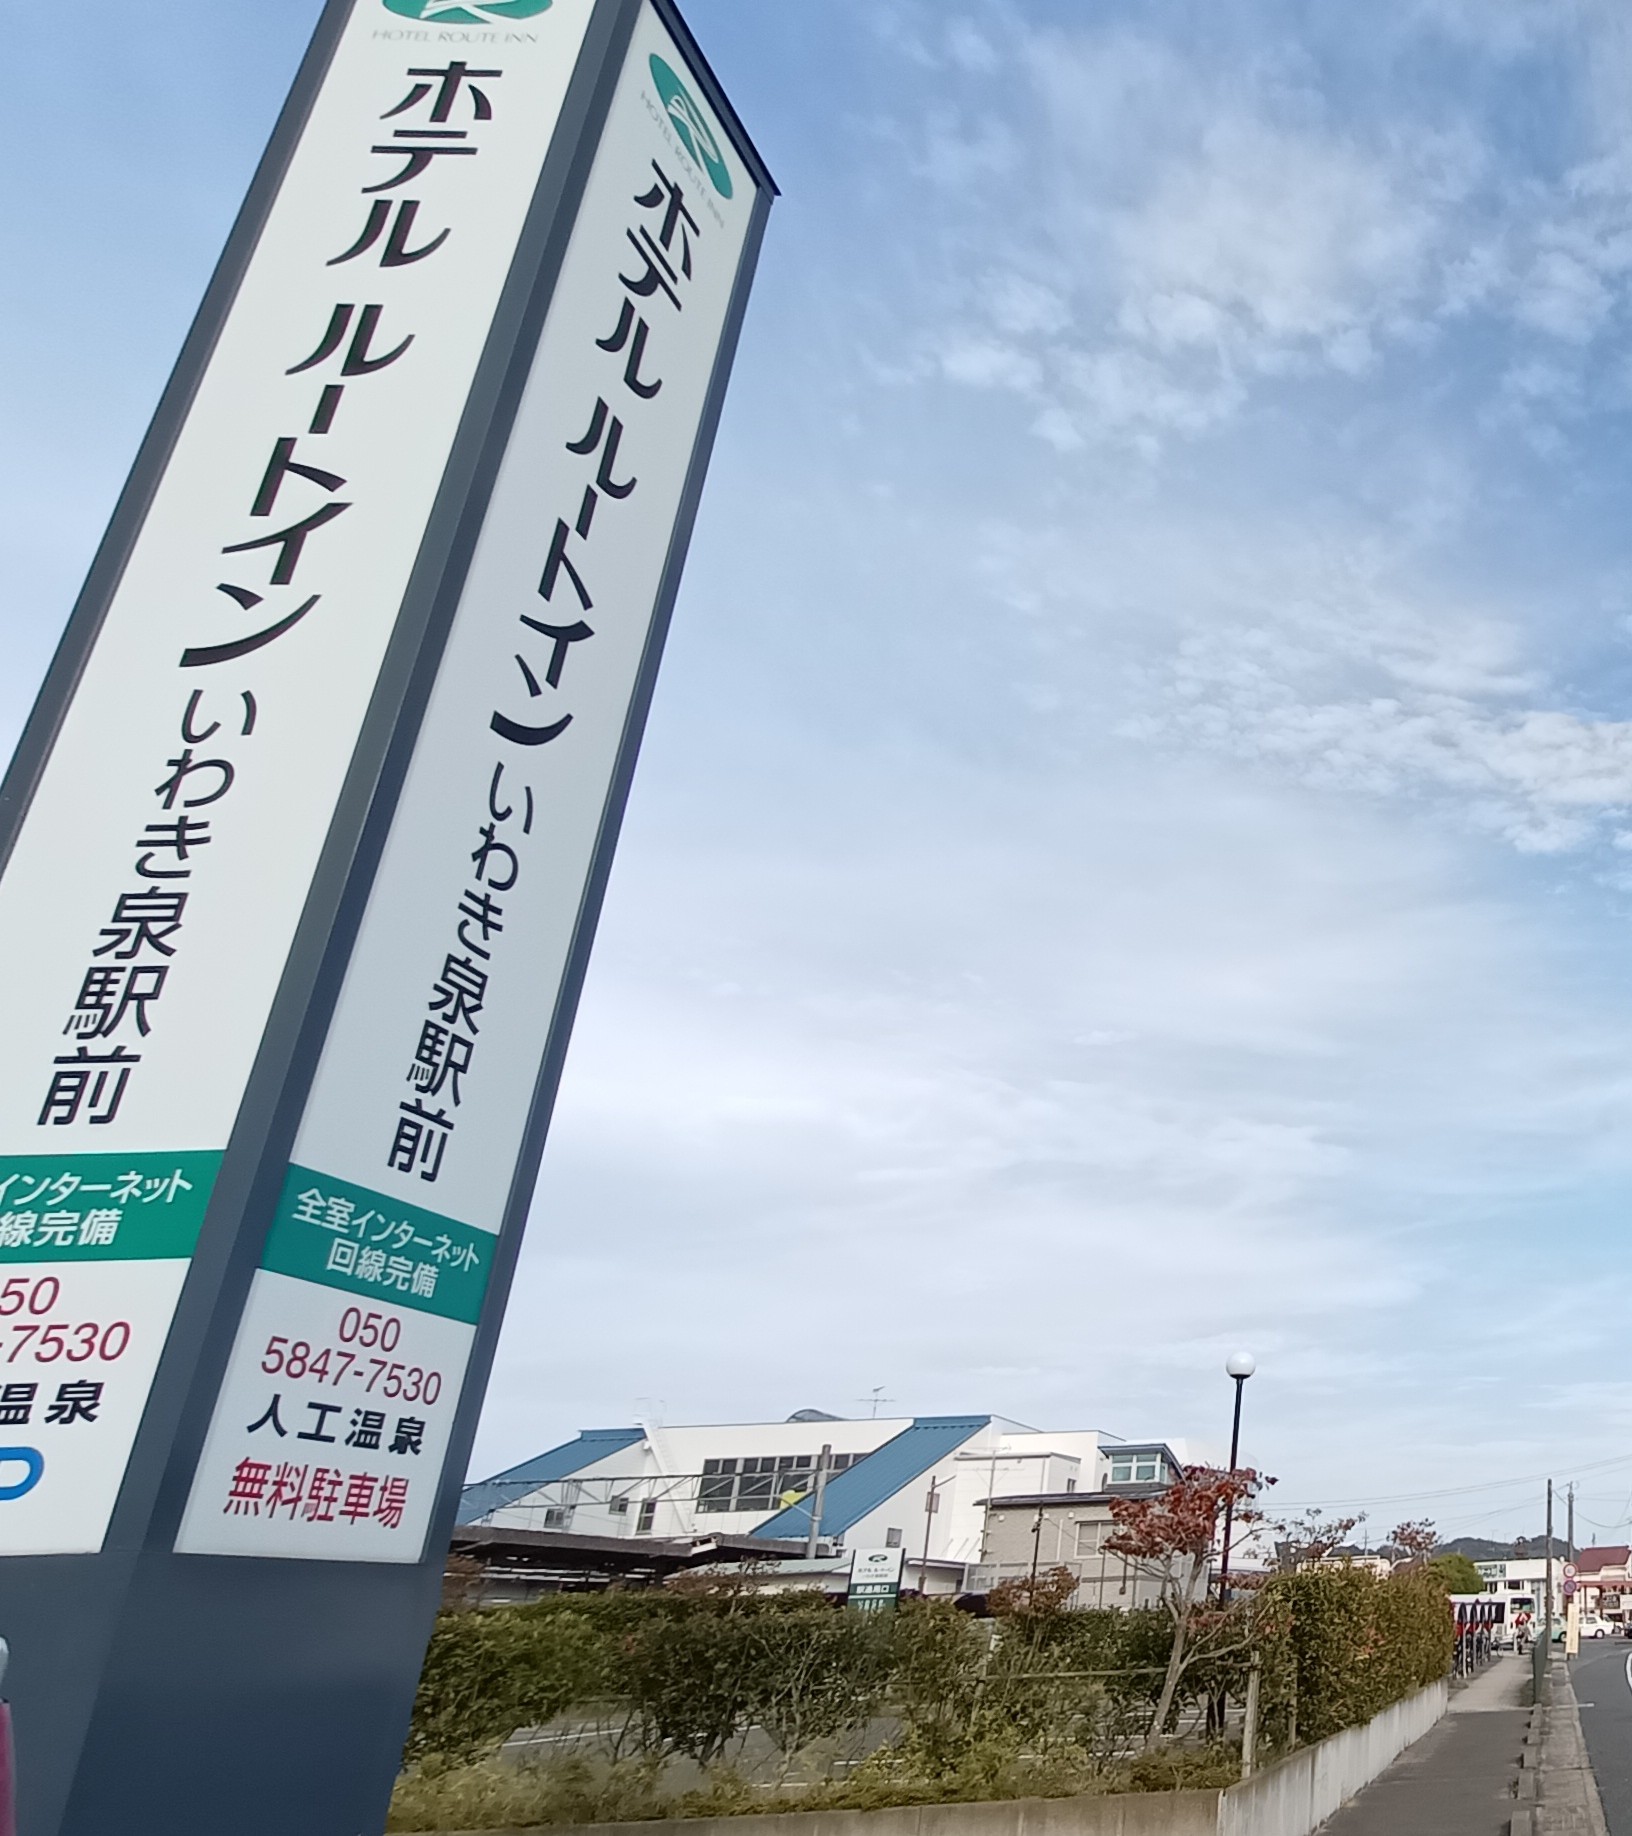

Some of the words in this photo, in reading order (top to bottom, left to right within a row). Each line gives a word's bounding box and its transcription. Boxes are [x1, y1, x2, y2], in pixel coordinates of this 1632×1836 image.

[372, 29, 430, 43] HOTEL
[437, 31, 499, 44] ROUTE
[504, 32, 539, 44] INN
[291, 1187, 481, 1273] 全室インターネット
[325, 1237, 440, 1299] 回線完備
[0, 1321, 131, 1364] 7530
[338, 1306, 402, 1353] 050
[260, 1335, 442, 1406] 5847-7530
[246, 1393, 427, 1456] 人工温泉
[222, 1456, 410, 1530] 無料駐車場
